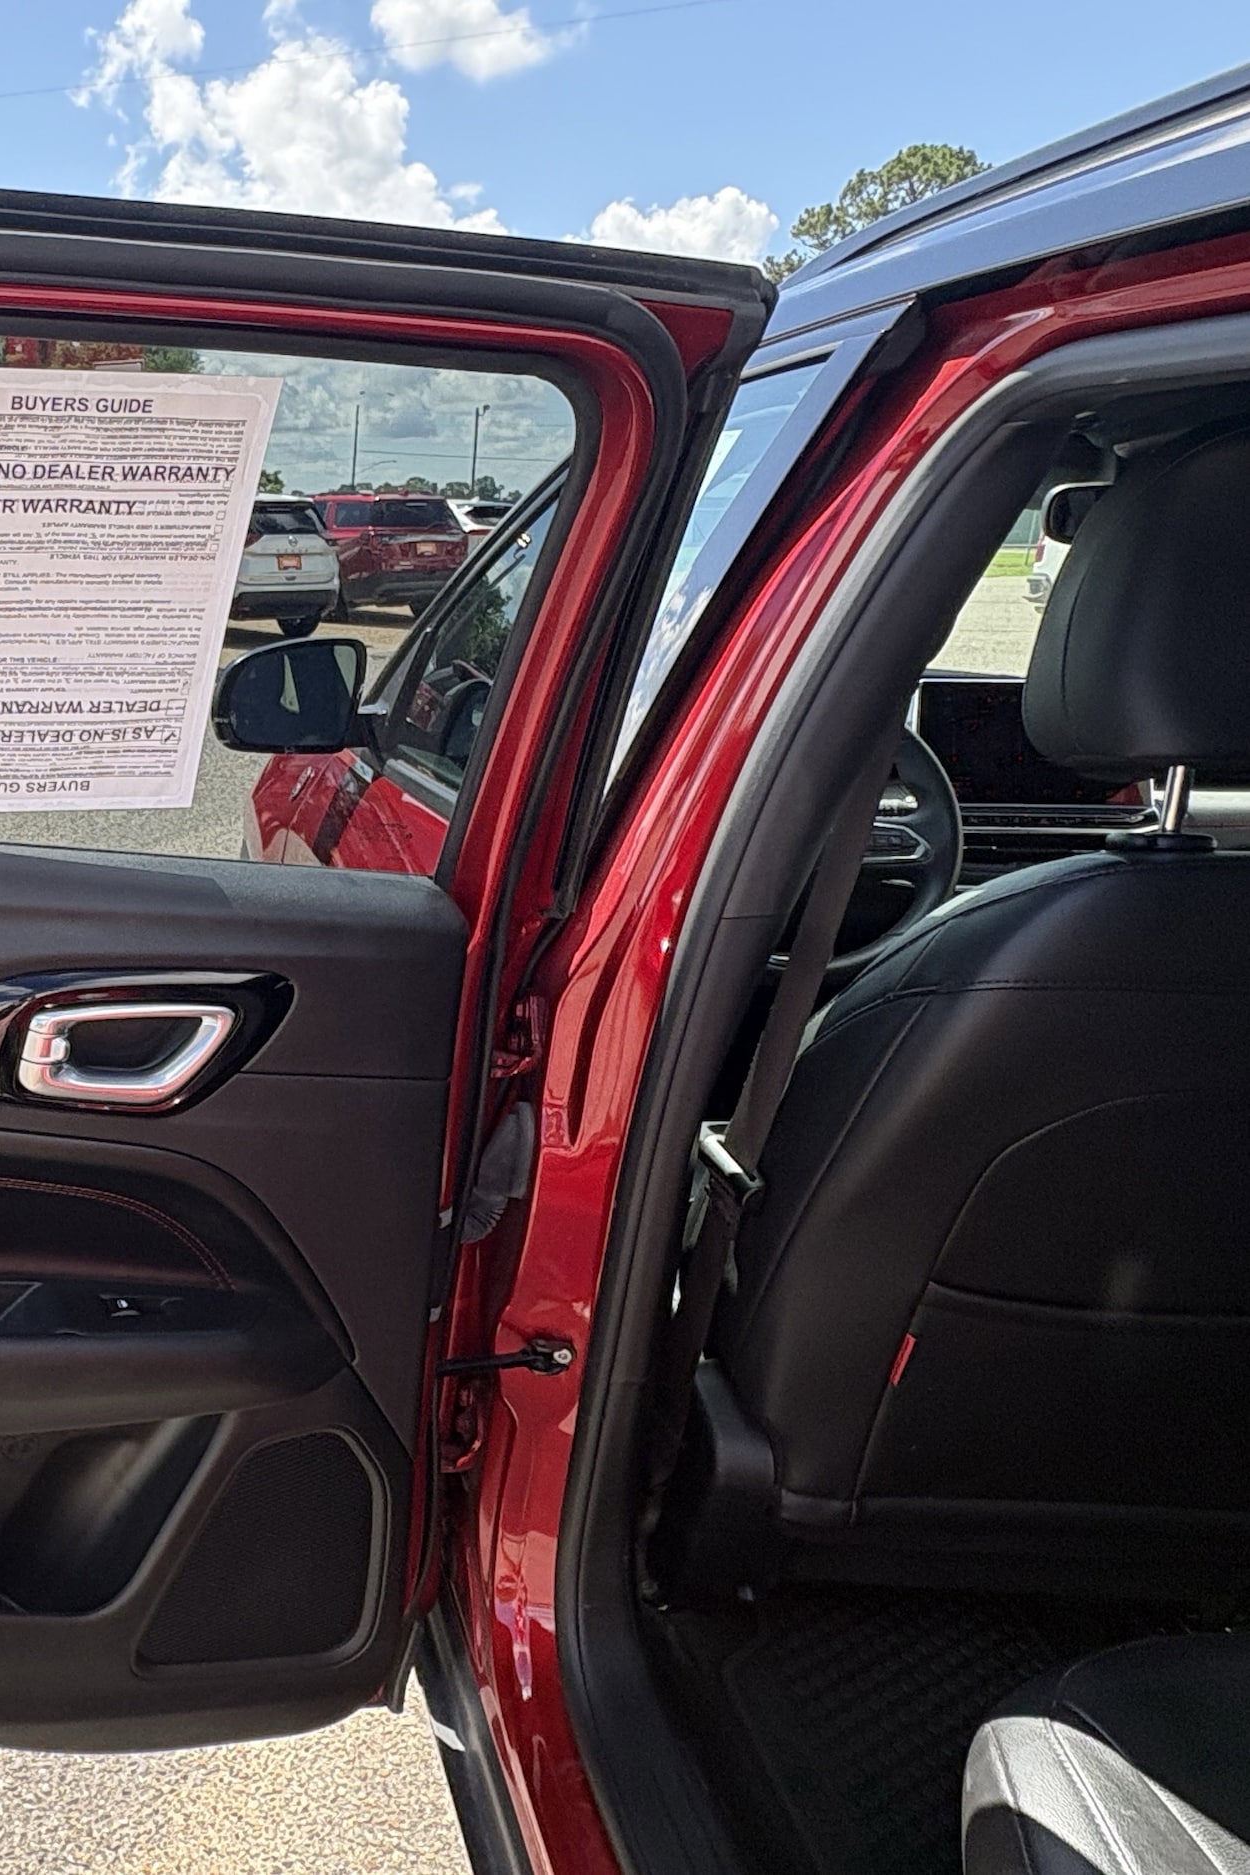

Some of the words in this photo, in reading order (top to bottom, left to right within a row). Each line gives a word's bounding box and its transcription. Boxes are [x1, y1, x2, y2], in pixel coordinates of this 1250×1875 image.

[11, 396, 88, 411] BUYERS
[95, 398, 152, 414] GUIDE
[33, 464, 114, 480] DEALER
[121, 464, 234, 483] WARRANTY
[22, 499, 136, 516] WARRANTY
[90, 700, 161, 713] DEALER
[2, 729, 74, 743] DEALER
[79, 727, 126, 742] IS-NO
[133, 726, 156, 739] AS
[26, 780, 89, 792] BUYERS
